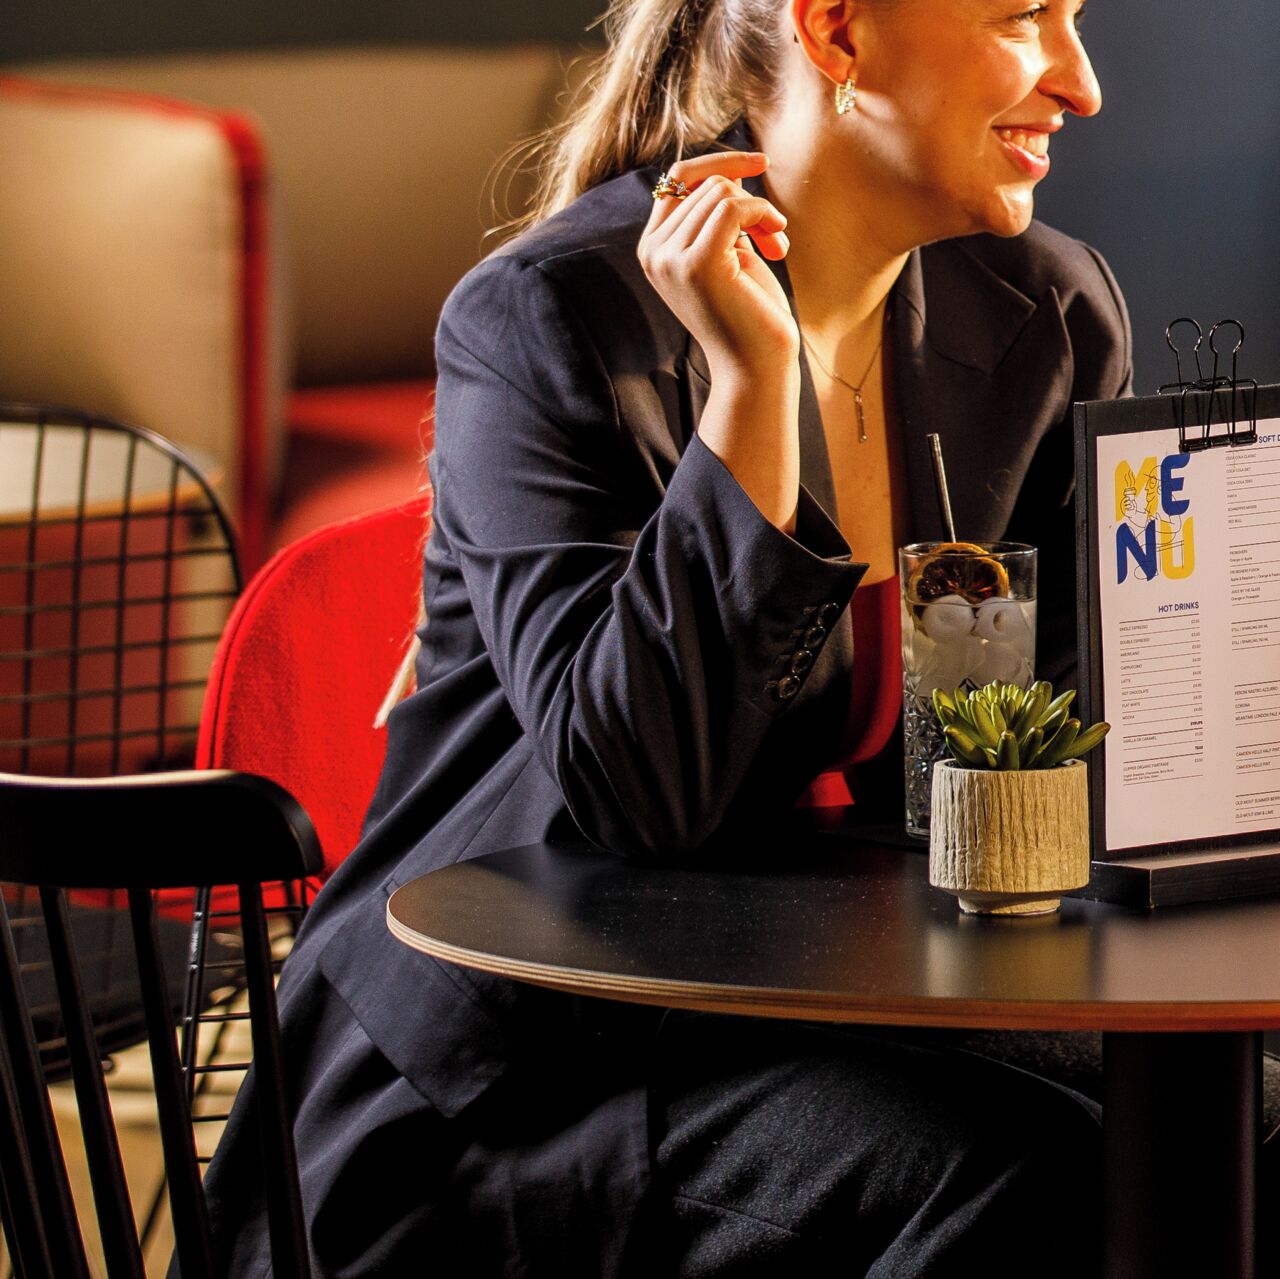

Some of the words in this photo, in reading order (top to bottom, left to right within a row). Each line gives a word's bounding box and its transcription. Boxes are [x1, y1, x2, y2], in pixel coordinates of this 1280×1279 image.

[1259, 435, 1276, 443] SOFT
[1158, 604, 1173, 613] HOT
[1174, 601, 1199, 611] DRINKS
